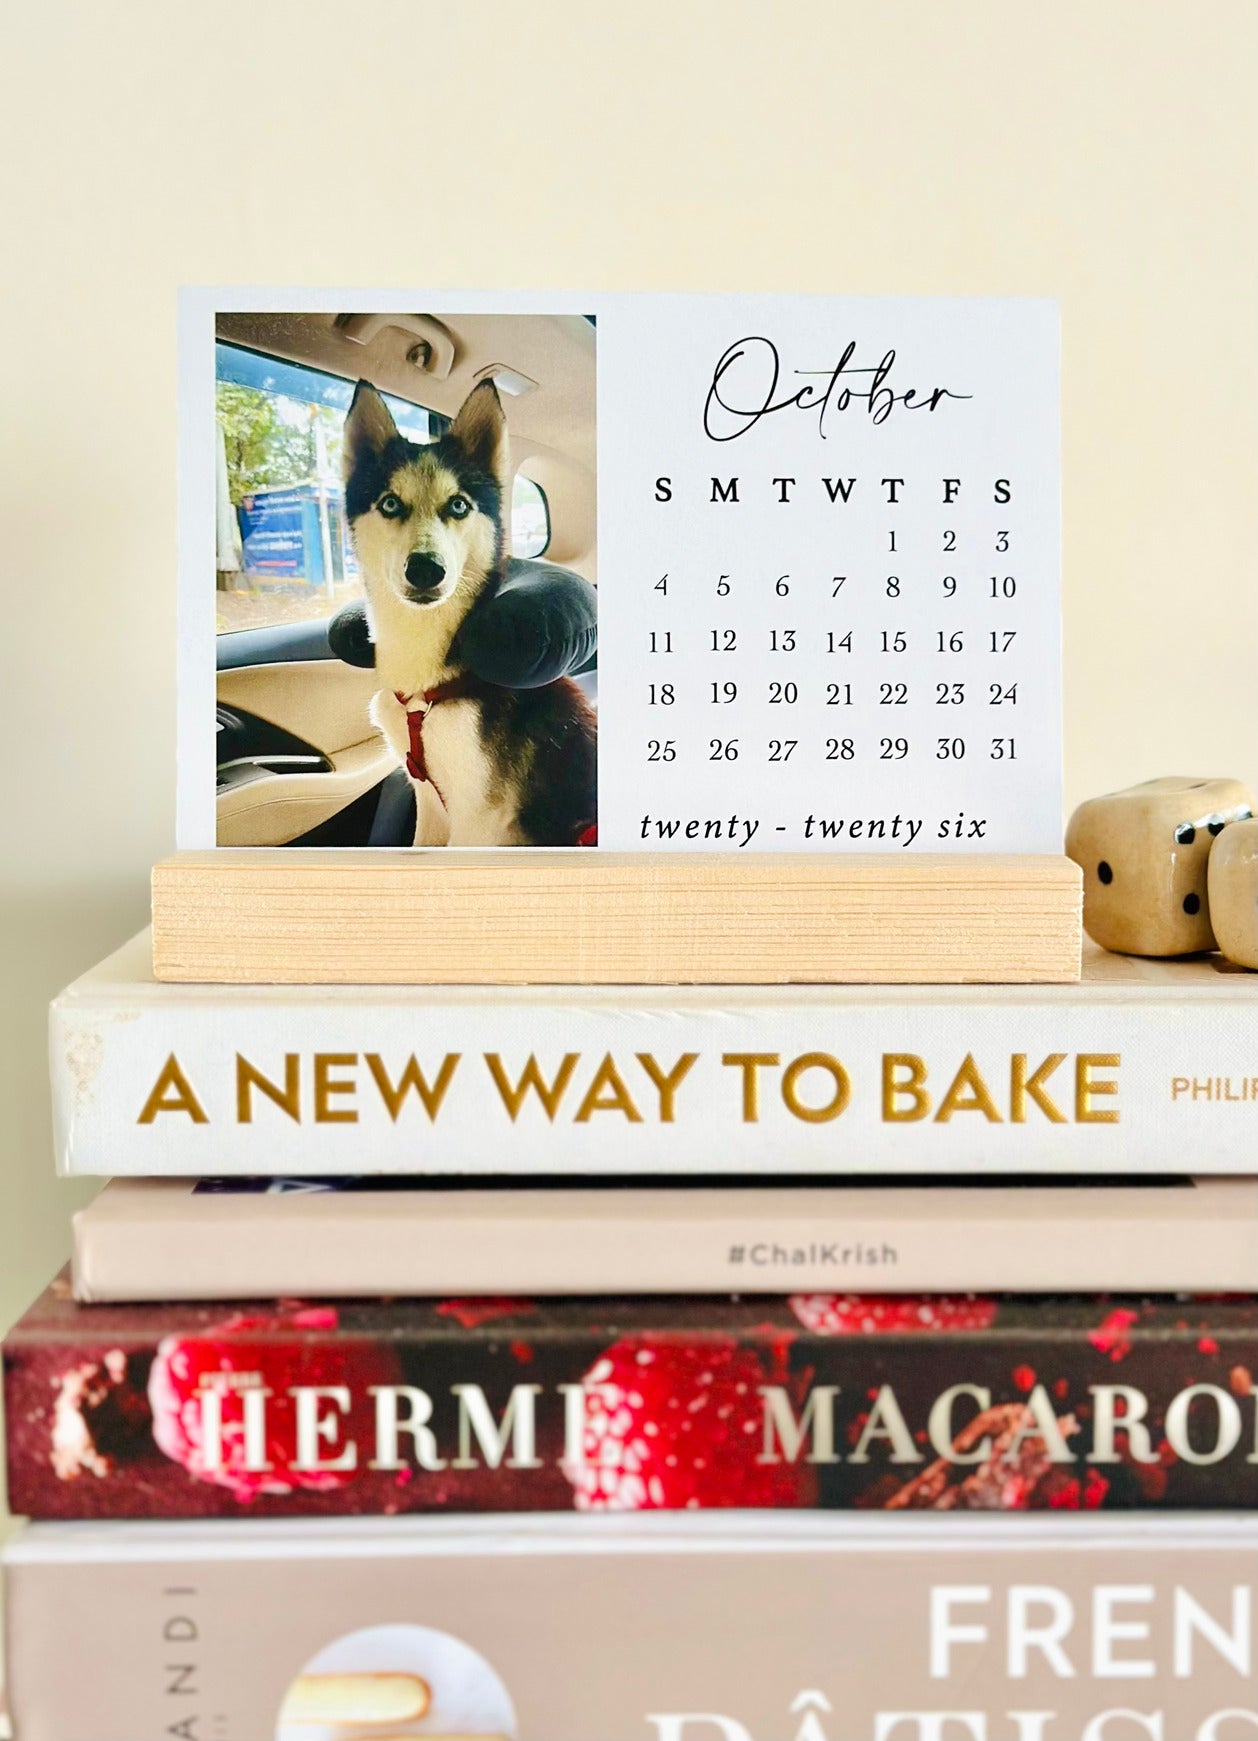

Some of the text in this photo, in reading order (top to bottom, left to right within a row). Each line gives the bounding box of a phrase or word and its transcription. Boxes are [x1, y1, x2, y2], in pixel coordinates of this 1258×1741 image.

[703, 336, 973, 442] October
[654, 476, 1011, 504] S M T W T F S
[888, 530, 1009, 553] 1 2 3
[653, 573, 1016, 598] 4 5 6 7 8 9 10
[649, 629, 1017, 653] 11 12 13 14 15 16 17
[648, 681, 1018, 706] 18 19 20 21 22 23 24
[647, 737, 1016, 762] 25 26 27 28 29 30 31
[640, 814, 760, 848] twenty
[804, 814, 923, 848] twenty
[937, 812, 987, 839] six
[136, 1051, 1122, 1125] A NEW WAY TO BAKE
[729, 1243, 898, 1266] #ChalKrish
[756, 1383, 1258, 1465] MACARO
[929, 1584, 1253, 1678] FREN
